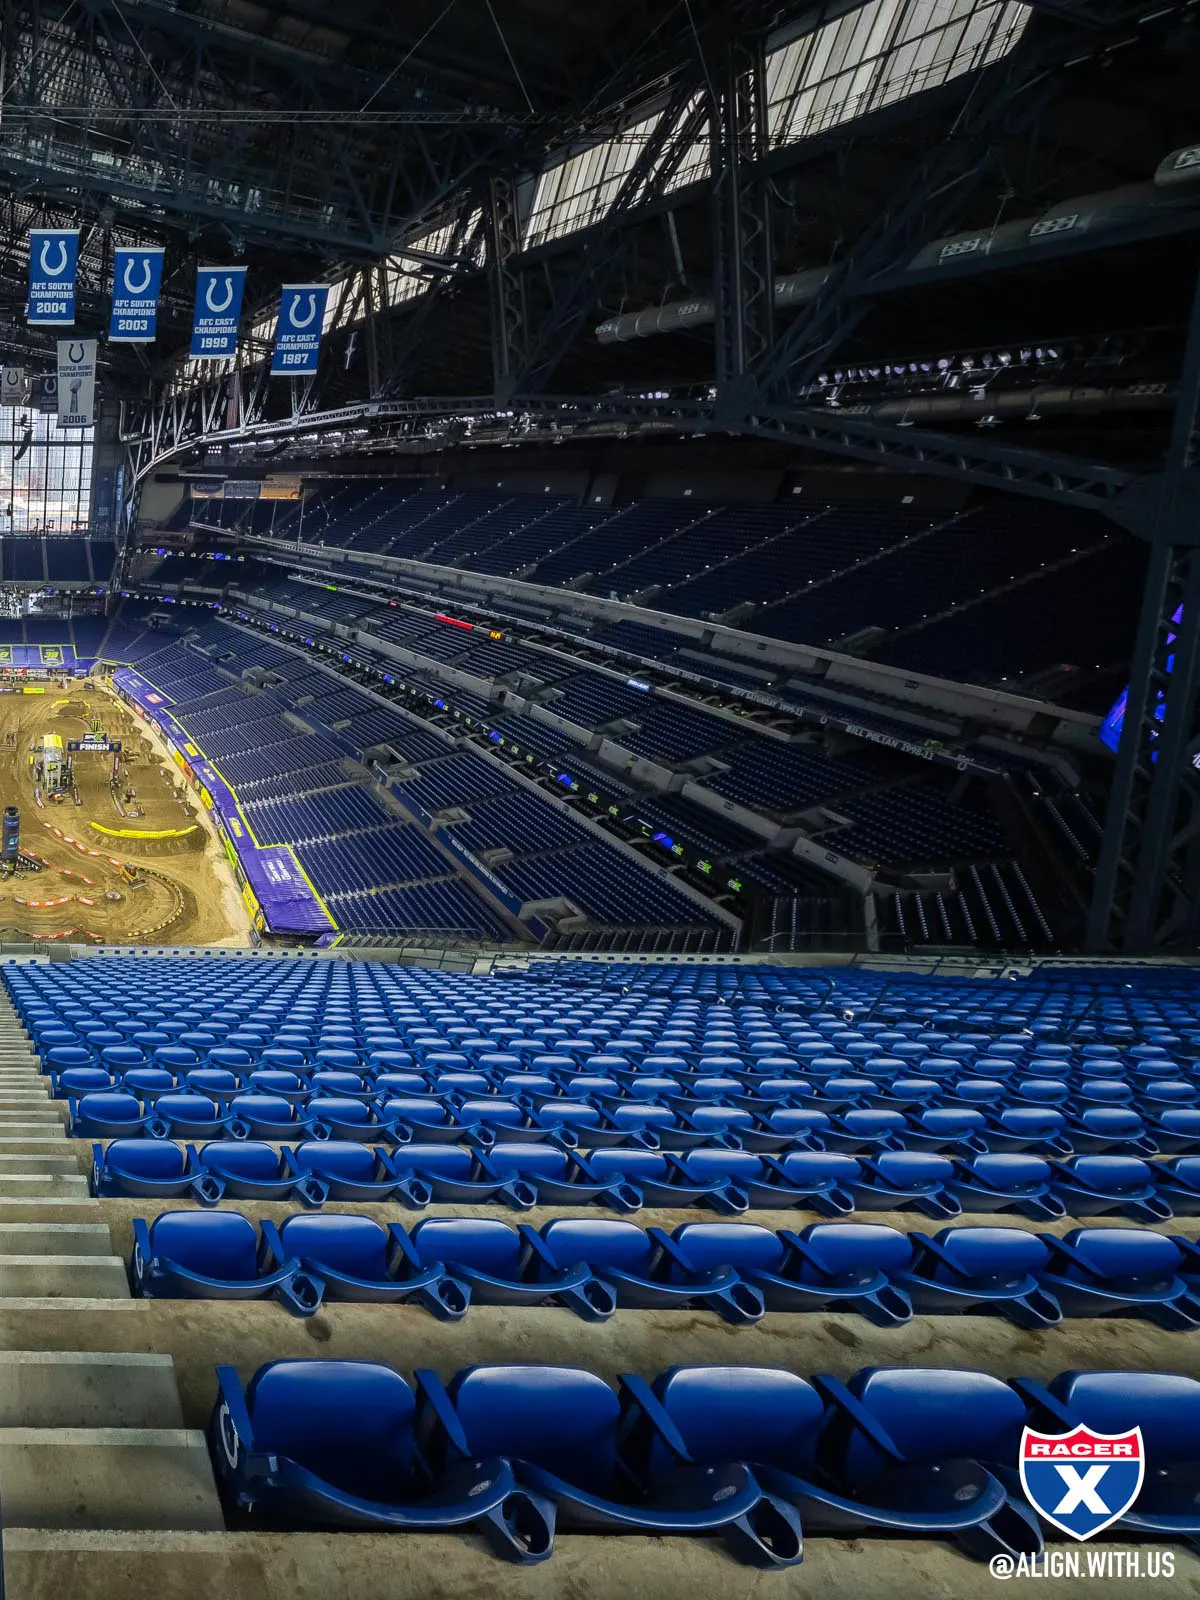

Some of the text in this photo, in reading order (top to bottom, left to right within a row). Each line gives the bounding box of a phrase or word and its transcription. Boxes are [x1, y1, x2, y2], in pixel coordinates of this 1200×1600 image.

[32, 282, 73, 290] AFC SOUTH
[30, 290, 74, 298] CHAMPIONS
[36, 302, 66, 314] 2004
[114, 300, 156, 308] AFC SOUTH
[113, 308, 156, 316] CHAMPIONS
[118, 320, 148, 331] 2003
[199, 318, 234, 326] AFC EAST
[194, 326, 237, 334] CHAMPIONS
[201, 338, 228, 348] 1999
[277, 342, 319, 350] CHAMPIONS
[282, 353, 308, 364] 1987
[63, 415, 86, 424] 2006
[846, 725, 863, 736] BILL
